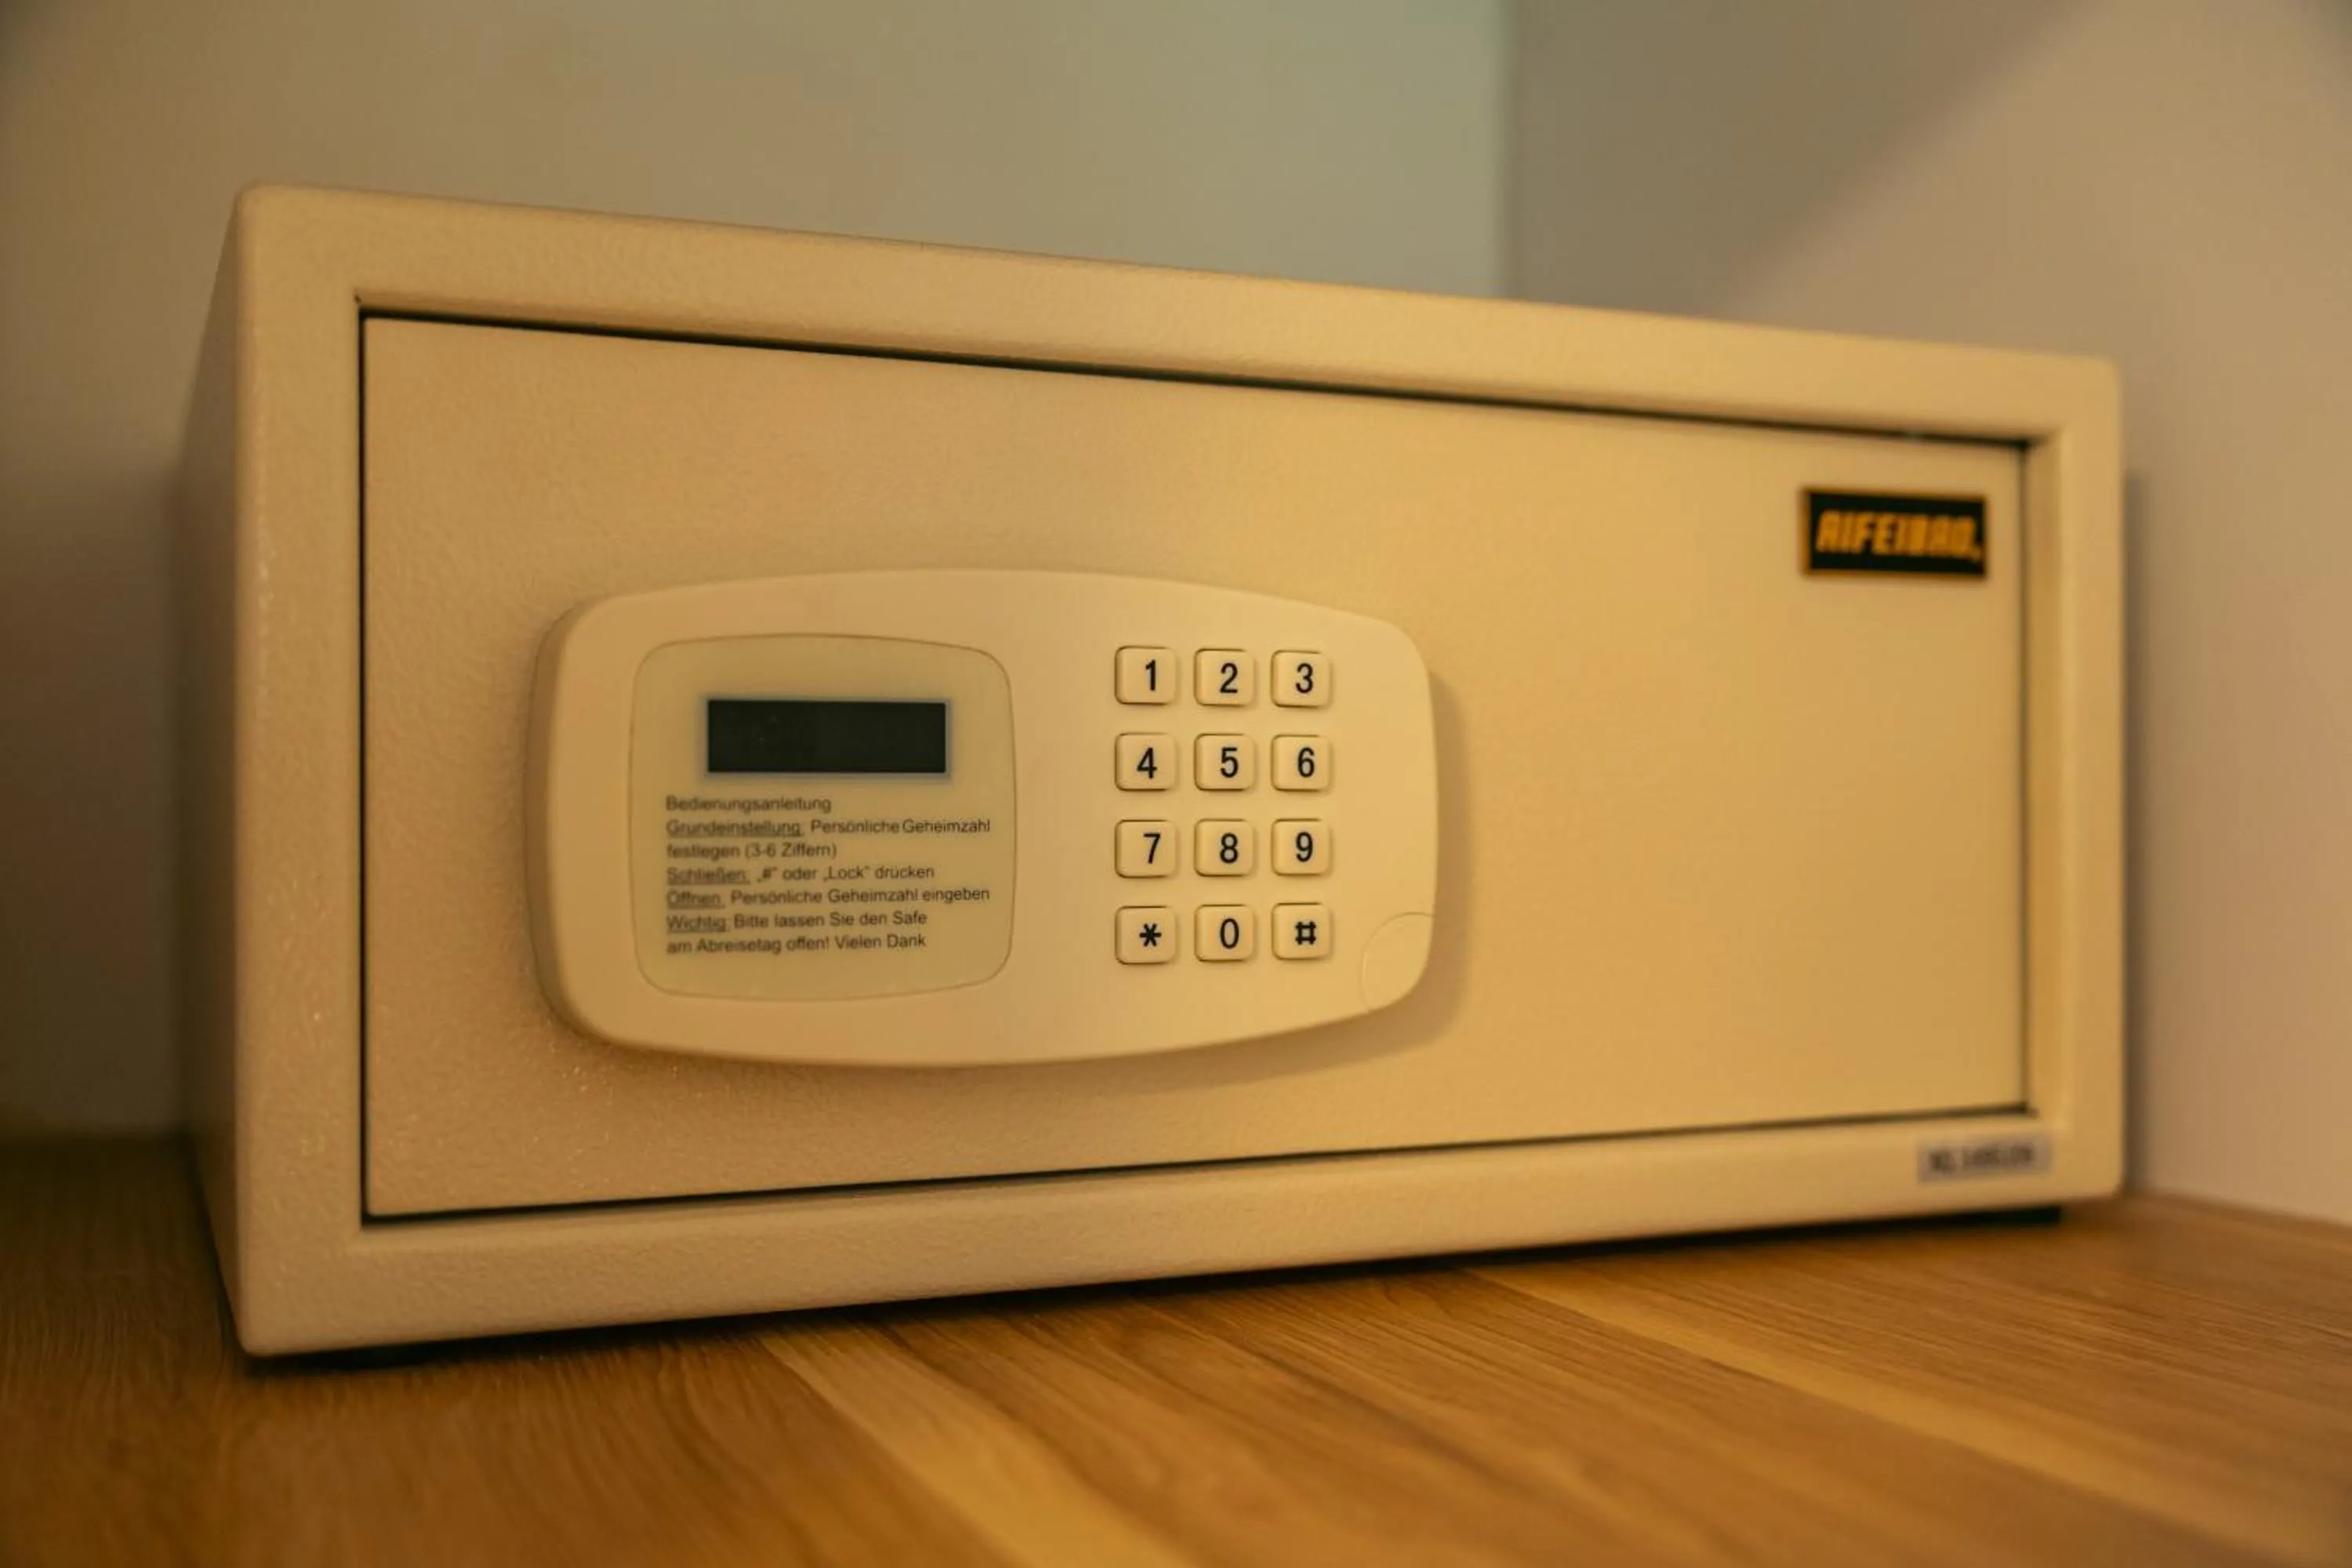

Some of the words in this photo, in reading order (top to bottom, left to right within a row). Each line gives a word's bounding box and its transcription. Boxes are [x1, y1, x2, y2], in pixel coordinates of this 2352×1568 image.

[1145, 659, 1156, 691] 1
[1219, 662, 1239, 694] 2
[1295, 662, 1314, 694] 3
[1136, 747, 1157, 779] 4
[1219, 747, 1240, 778] 5
[1297, 747, 1316, 778] 6
[666, 796, 832, 815] Bedienungsanleitung
[811, 819, 899, 834] Persönliche
[902, 818, 990, 833] Geheimzahl
[666, 842, 739, 860] festlegen
[745, 842, 776, 860] (3-6
[781, 842, 837, 859] Ziffern)
[1143, 833, 1161, 864] 7
[1219, 833, 1239, 864] 8
[1295, 832, 1313, 862] 9
[782, 866, 816, 880] oder
[874, 865, 935, 880] drücken
[731, 890, 822, 905] Persönliche
[827, 888, 918, 903] Geheimzahl
[922, 887, 990, 904] eingeben
[733, 913, 768, 929] Bitte
[774, 913, 825, 928] lassen
[829, 912, 855, 927] Sie
[858, 912, 887, 926] den
[892, 910, 927, 925] Safe
[1219, 918, 1240, 949] 0
[666, 941, 692, 955] am
[696, 937, 782, 955] Abreisetag
[786, 936, 830, 951] offen!
[834, 935, 882, 950] Vielen
[887, 934, 927, 949] Dank
